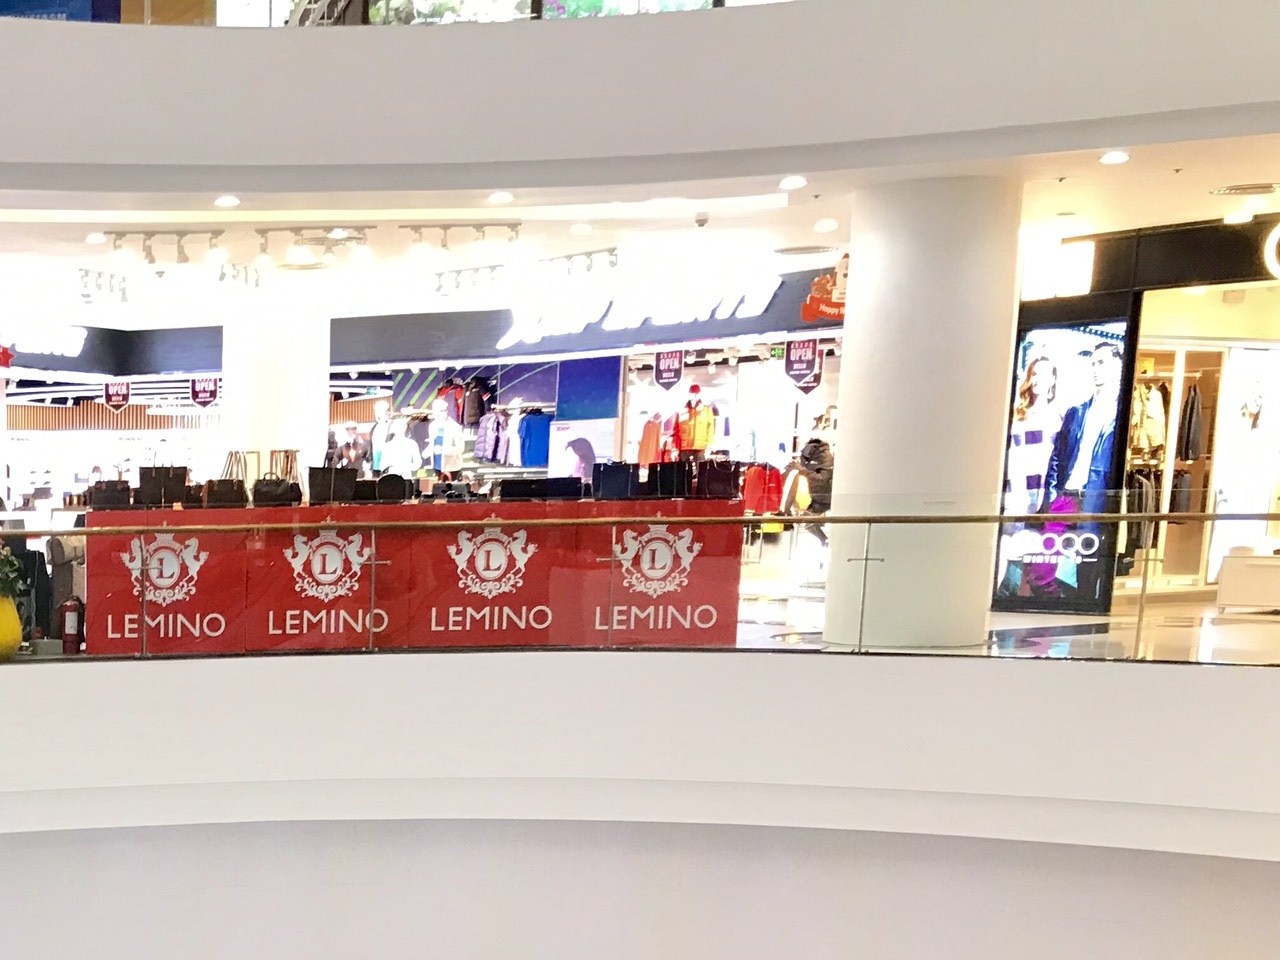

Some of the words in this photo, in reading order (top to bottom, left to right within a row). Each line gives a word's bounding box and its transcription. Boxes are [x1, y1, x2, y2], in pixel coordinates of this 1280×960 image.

[818, 303, 839, 315] Happy
[660, 358, 679, 370] OPEN
[790, 348, 814, 361] OPEN
[108, 385, 128, 395] OPEN
[195, 381, 216, 392] OPEN
[157, 558, 175, 579] L
[319, 553, 338, 575] L
[481, 549, 502, 571] L
[647, 549, 667, 571] L
[107, 613, 226, 639] LEMINO
[268, 608, 389, 635] LEMINO
[430, 604, 553, 631] LEMINO
[595, 604, 718, 630] LEMINO
